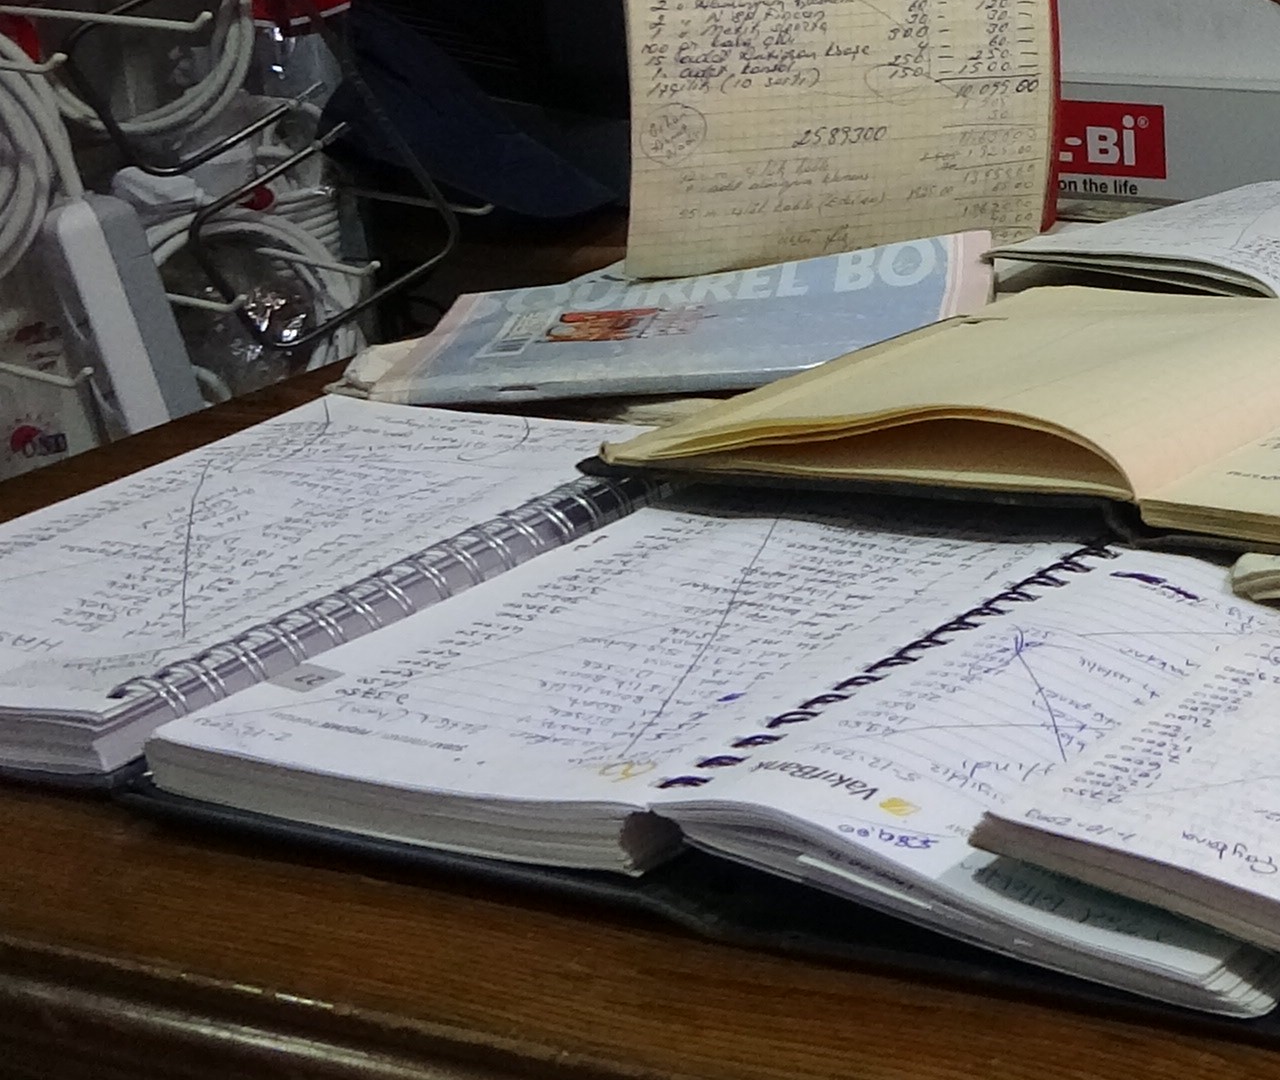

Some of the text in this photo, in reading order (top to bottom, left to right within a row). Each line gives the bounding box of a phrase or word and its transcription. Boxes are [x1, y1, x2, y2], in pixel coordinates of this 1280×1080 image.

[1059, 114, 1136, 167] -Bi
[1081, 178, 1110, 194] the
[1112, 178, 1138, 195] life
